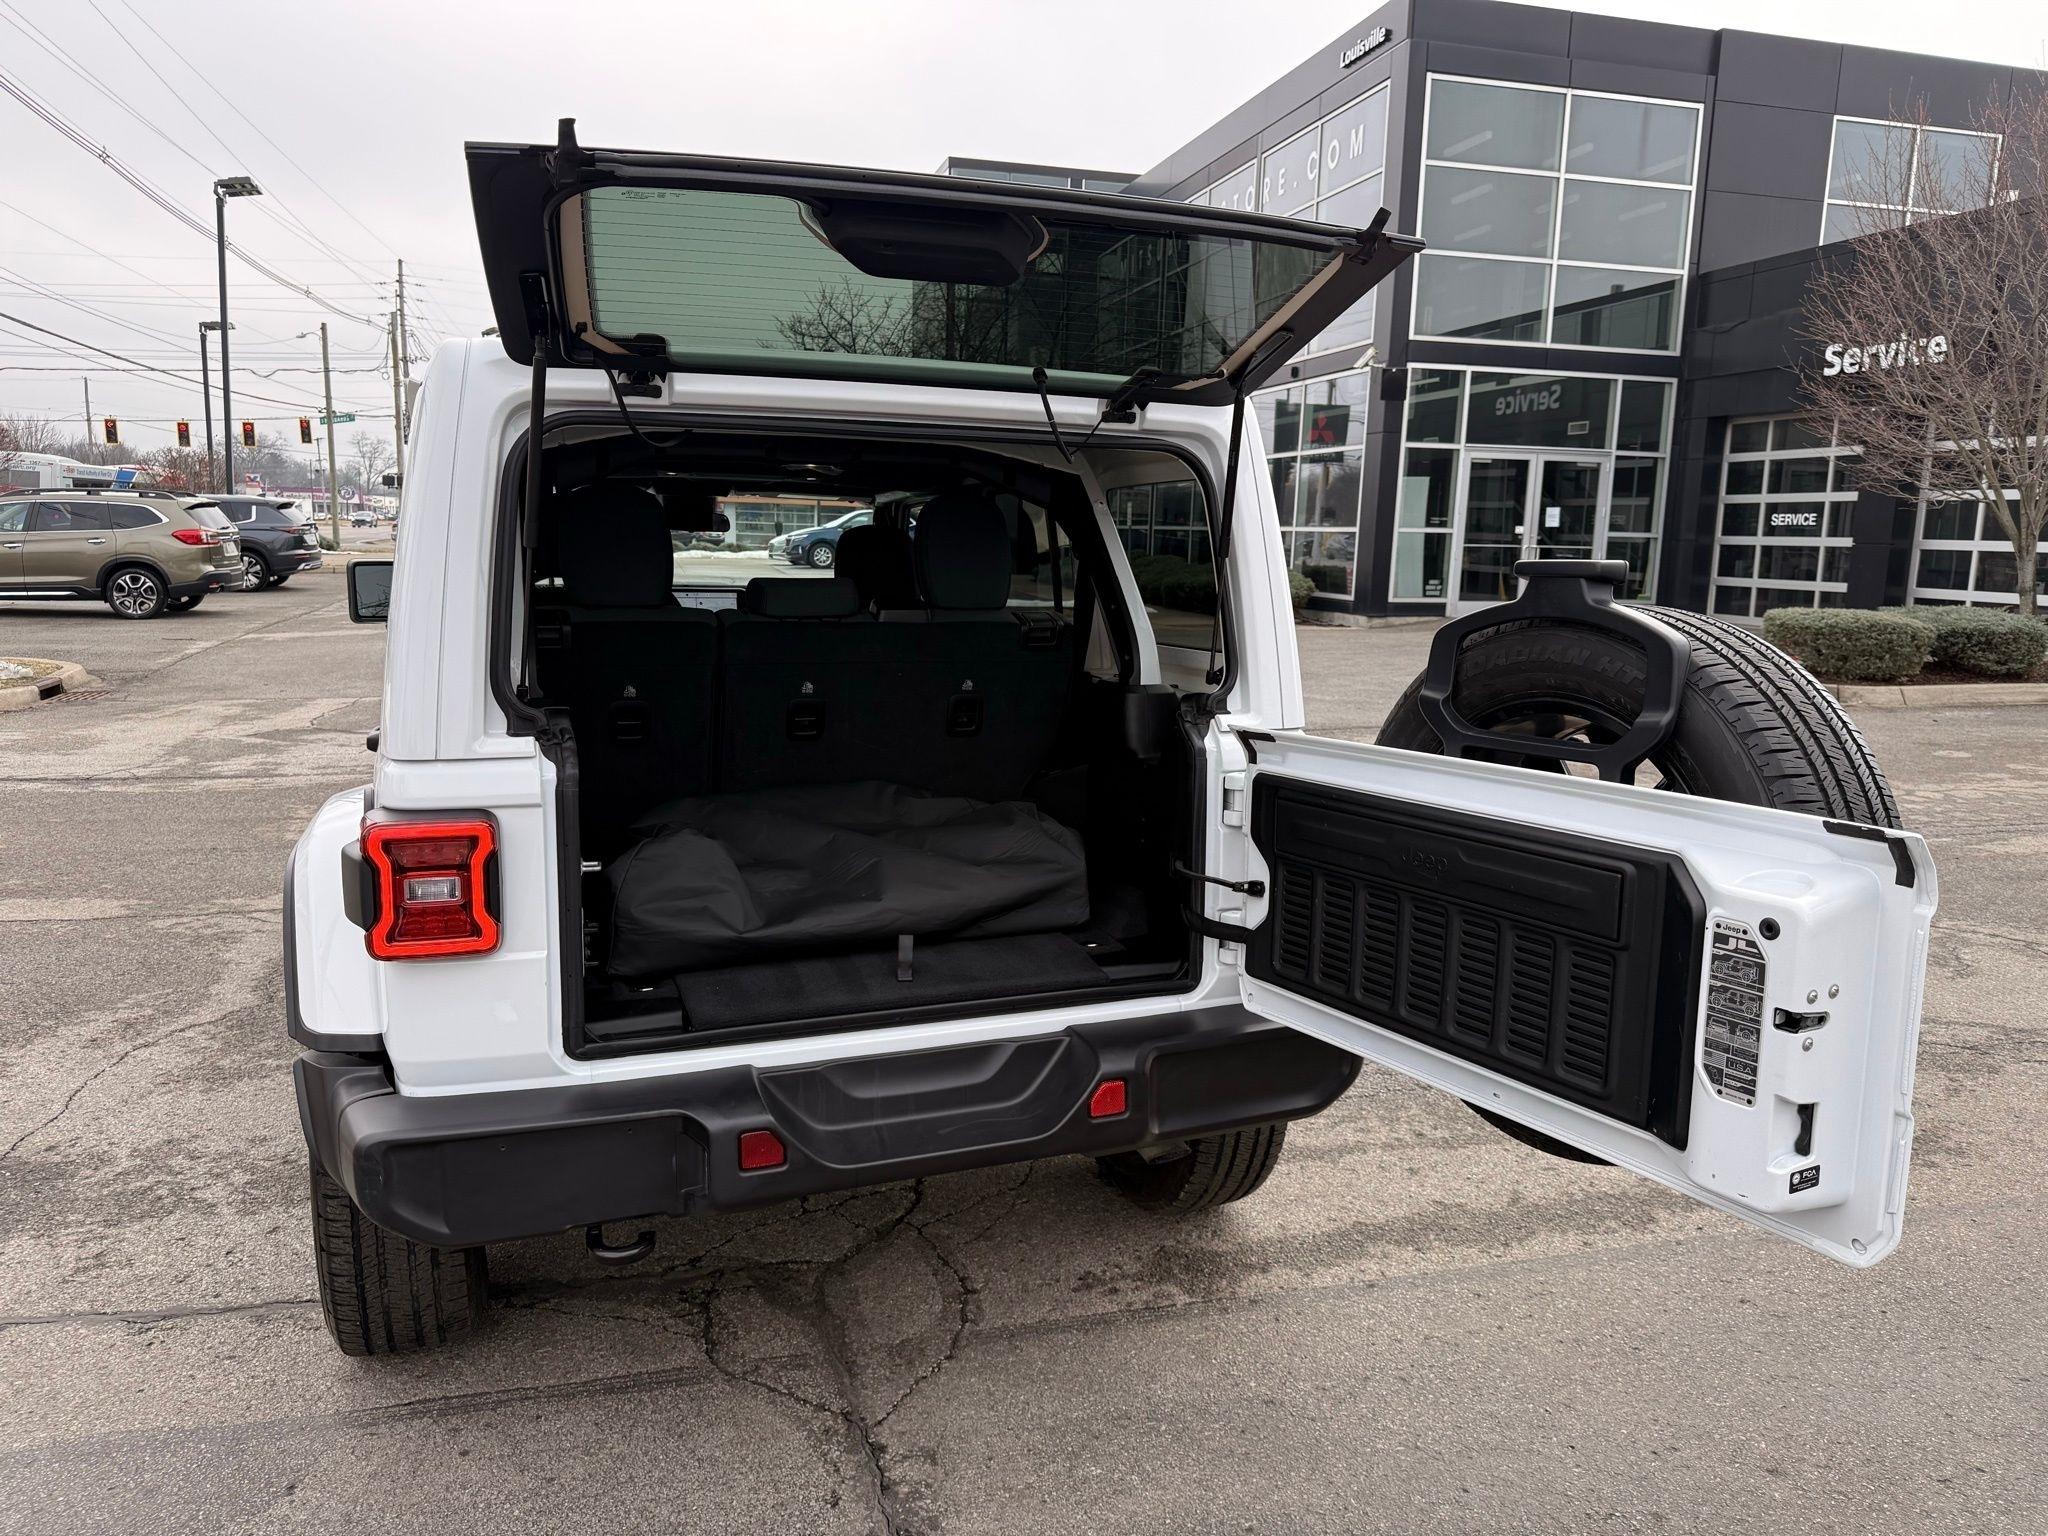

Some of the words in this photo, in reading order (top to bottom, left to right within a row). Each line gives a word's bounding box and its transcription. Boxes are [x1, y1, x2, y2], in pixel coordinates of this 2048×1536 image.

[1339, 26, 1386, 68] Louisville
[1770, 513, 1818, 526] SERVICE
[1722, 924, 1742, 935] Jeep
[1714, 937, 1760, 954] JL
[1728, 1061, 1754, 1076] USA
[1802, 1169, 1817, 1179] FCA
